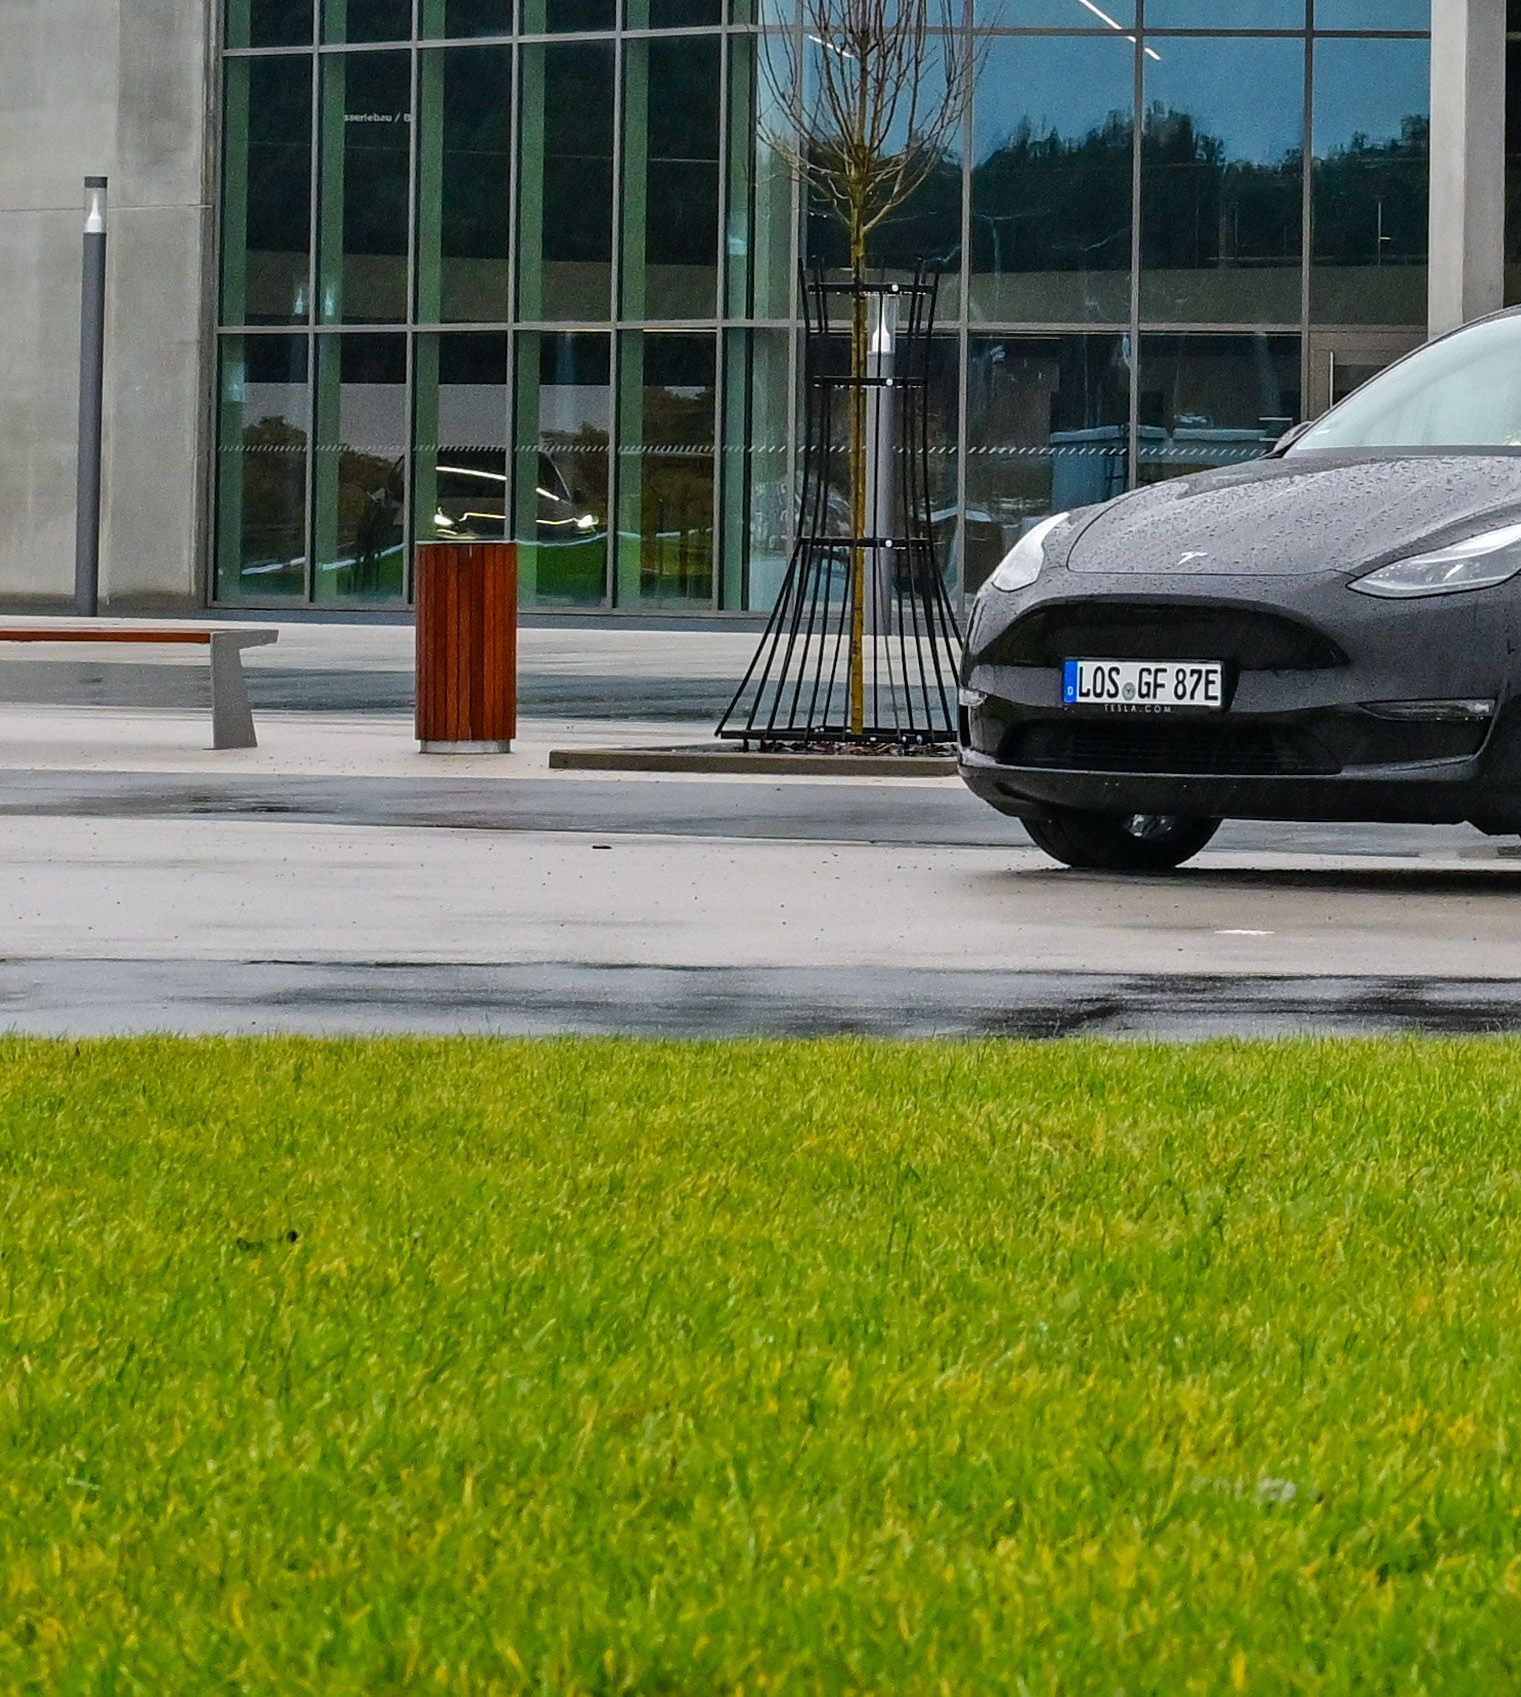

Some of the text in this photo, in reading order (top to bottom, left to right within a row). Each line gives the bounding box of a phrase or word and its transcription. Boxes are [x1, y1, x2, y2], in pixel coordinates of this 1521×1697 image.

[1079, 665, 1120, 699] LOS
[1137, 667, 1168, 699] GF
[1173, 668, 1219, 701] 87E
